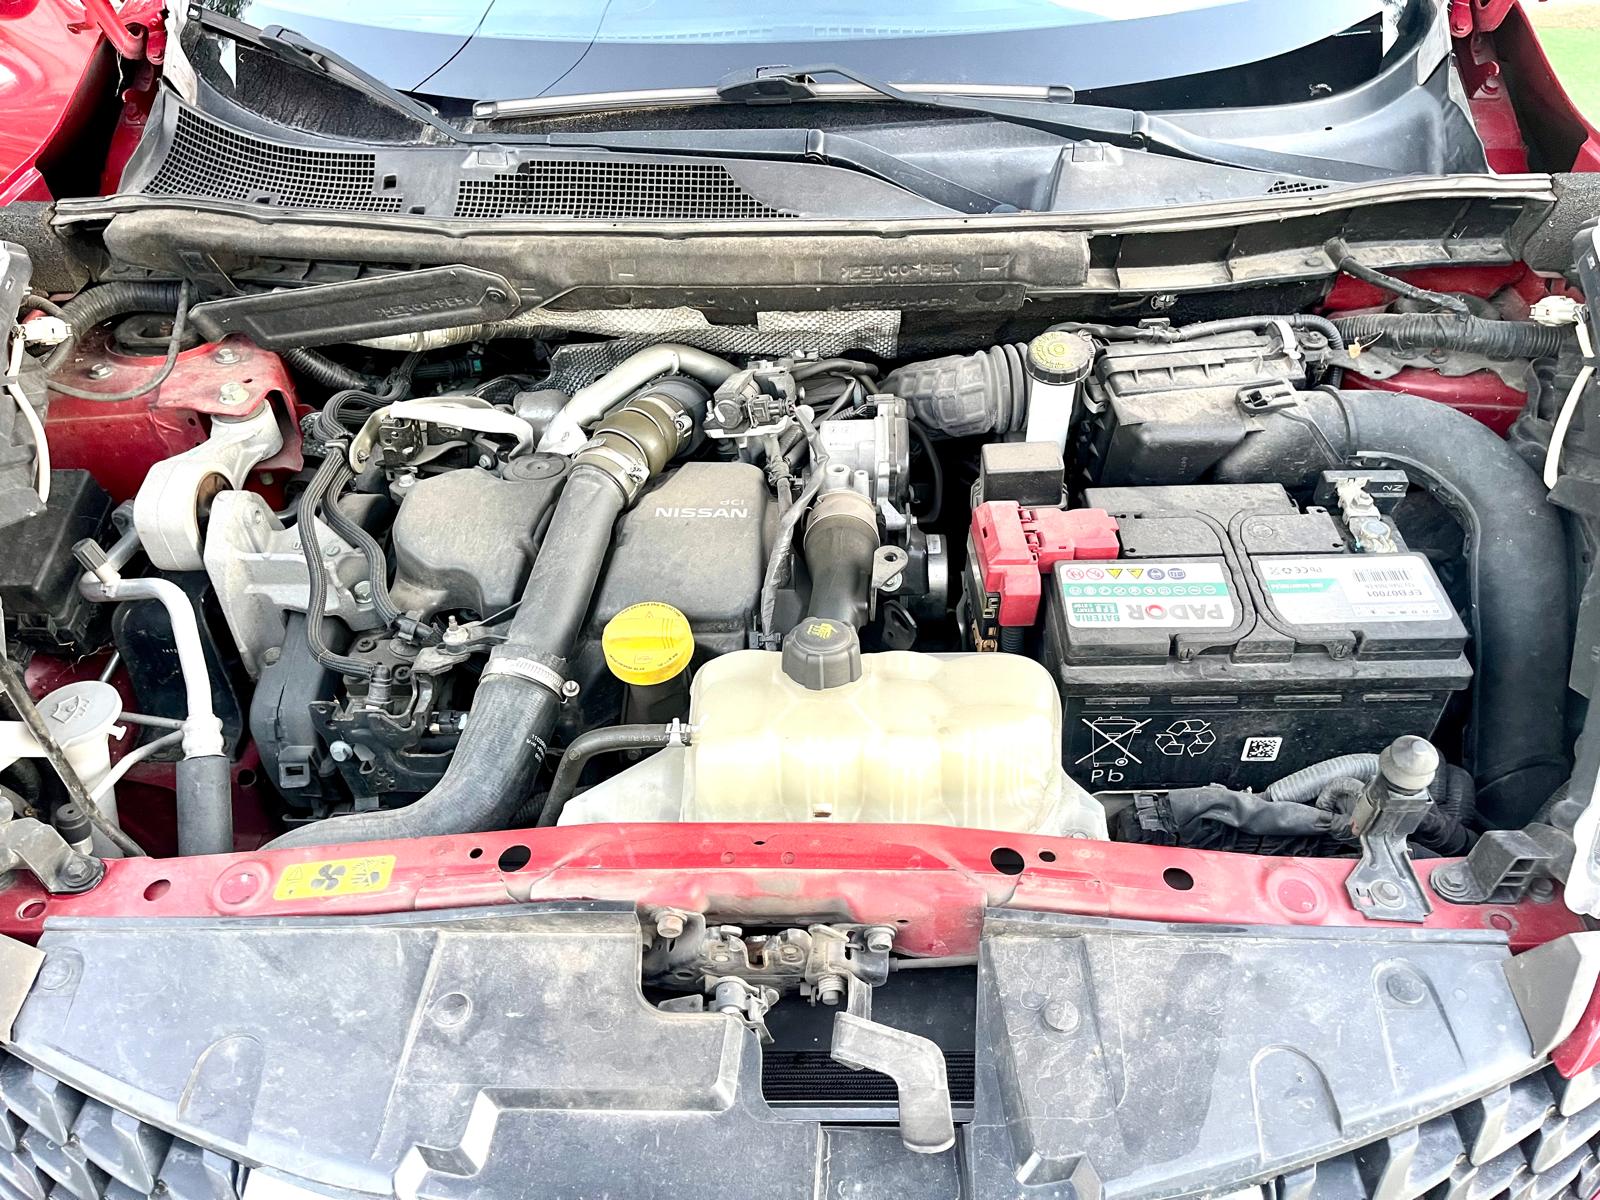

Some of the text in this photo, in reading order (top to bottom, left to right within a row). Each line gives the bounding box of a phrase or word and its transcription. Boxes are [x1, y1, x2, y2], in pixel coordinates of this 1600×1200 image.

[654, 507, 748, 518] NISSAN
[1074, 613, 1121, 622] BATERIA
[1125, 604, 1225, 621] PADOR
[1090, 768, 1125, 783] Pb
